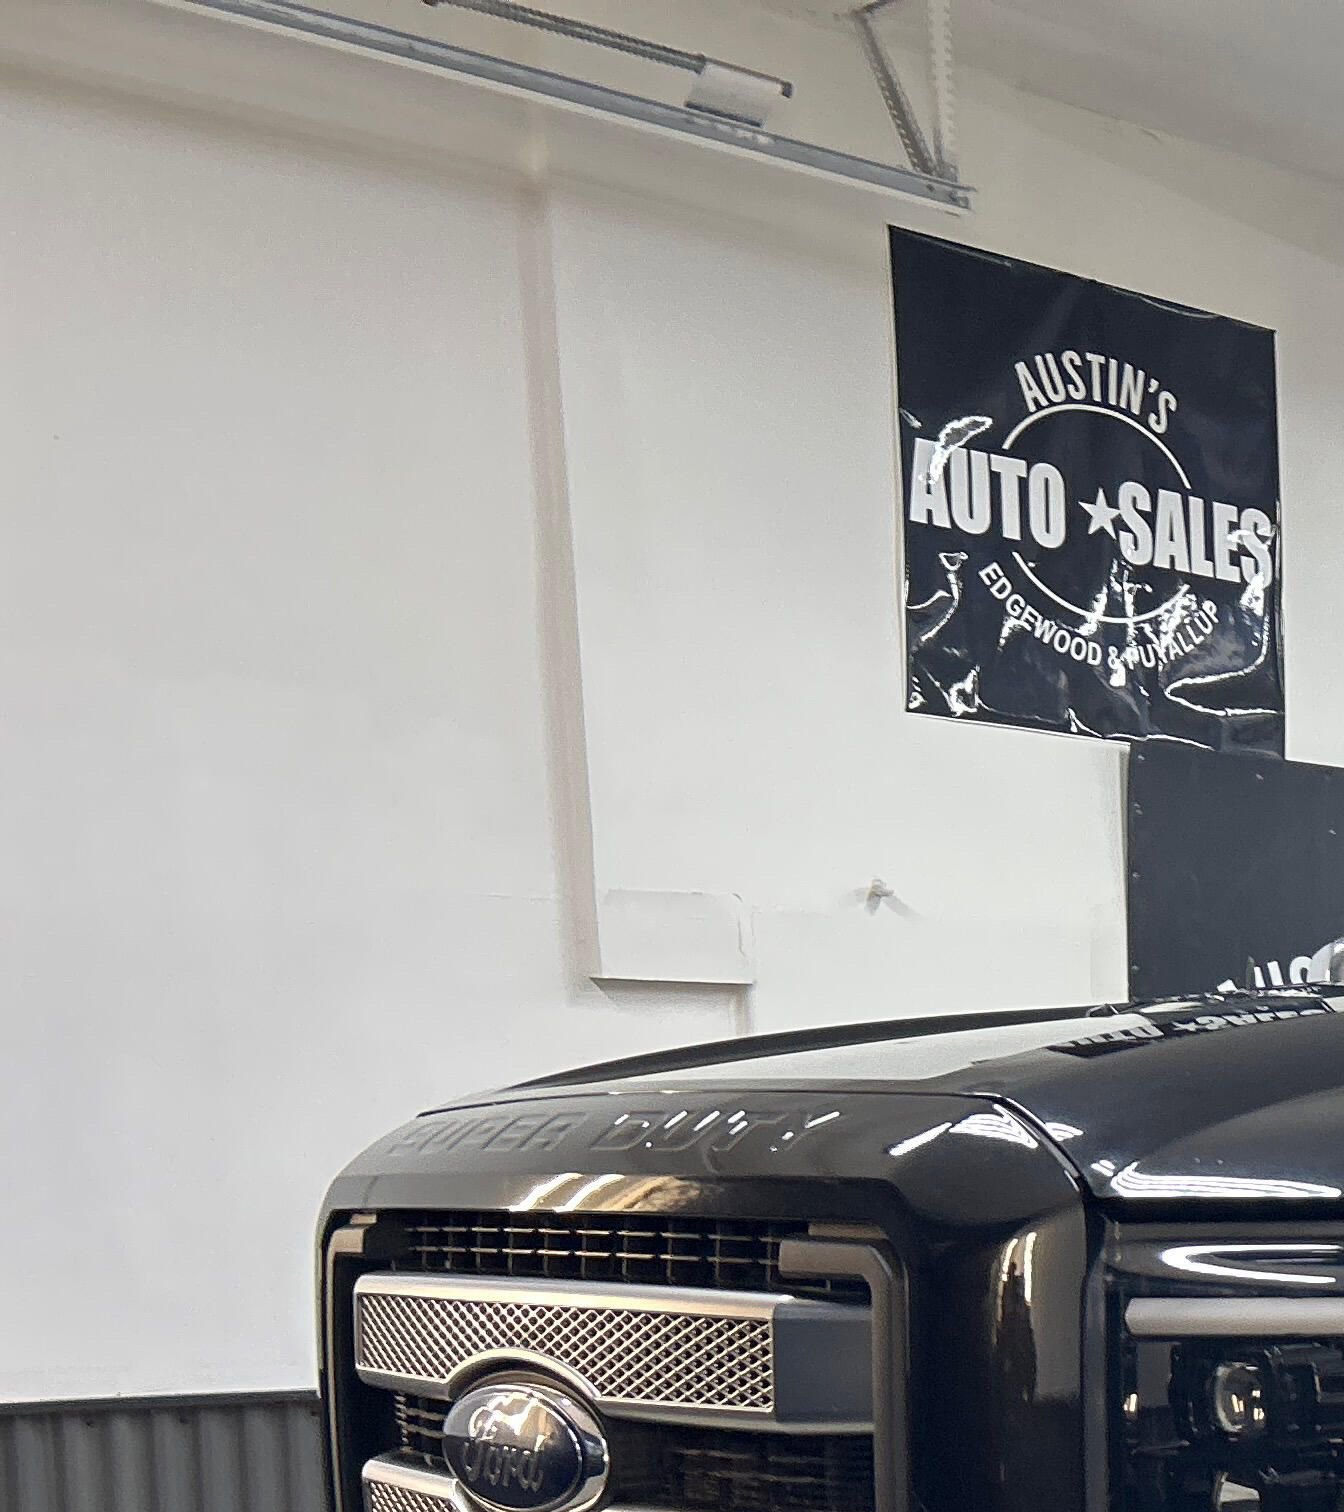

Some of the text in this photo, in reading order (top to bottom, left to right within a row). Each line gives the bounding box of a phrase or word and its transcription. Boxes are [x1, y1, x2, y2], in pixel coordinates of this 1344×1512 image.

[1013, 349, 1178, 435] AUSTIN'S
[909, 437, 1275, 591] AUTO SALES
[978, 561, 1102, 667] EDGEWOOD
[463, 1406, 546, 1492] Ford
